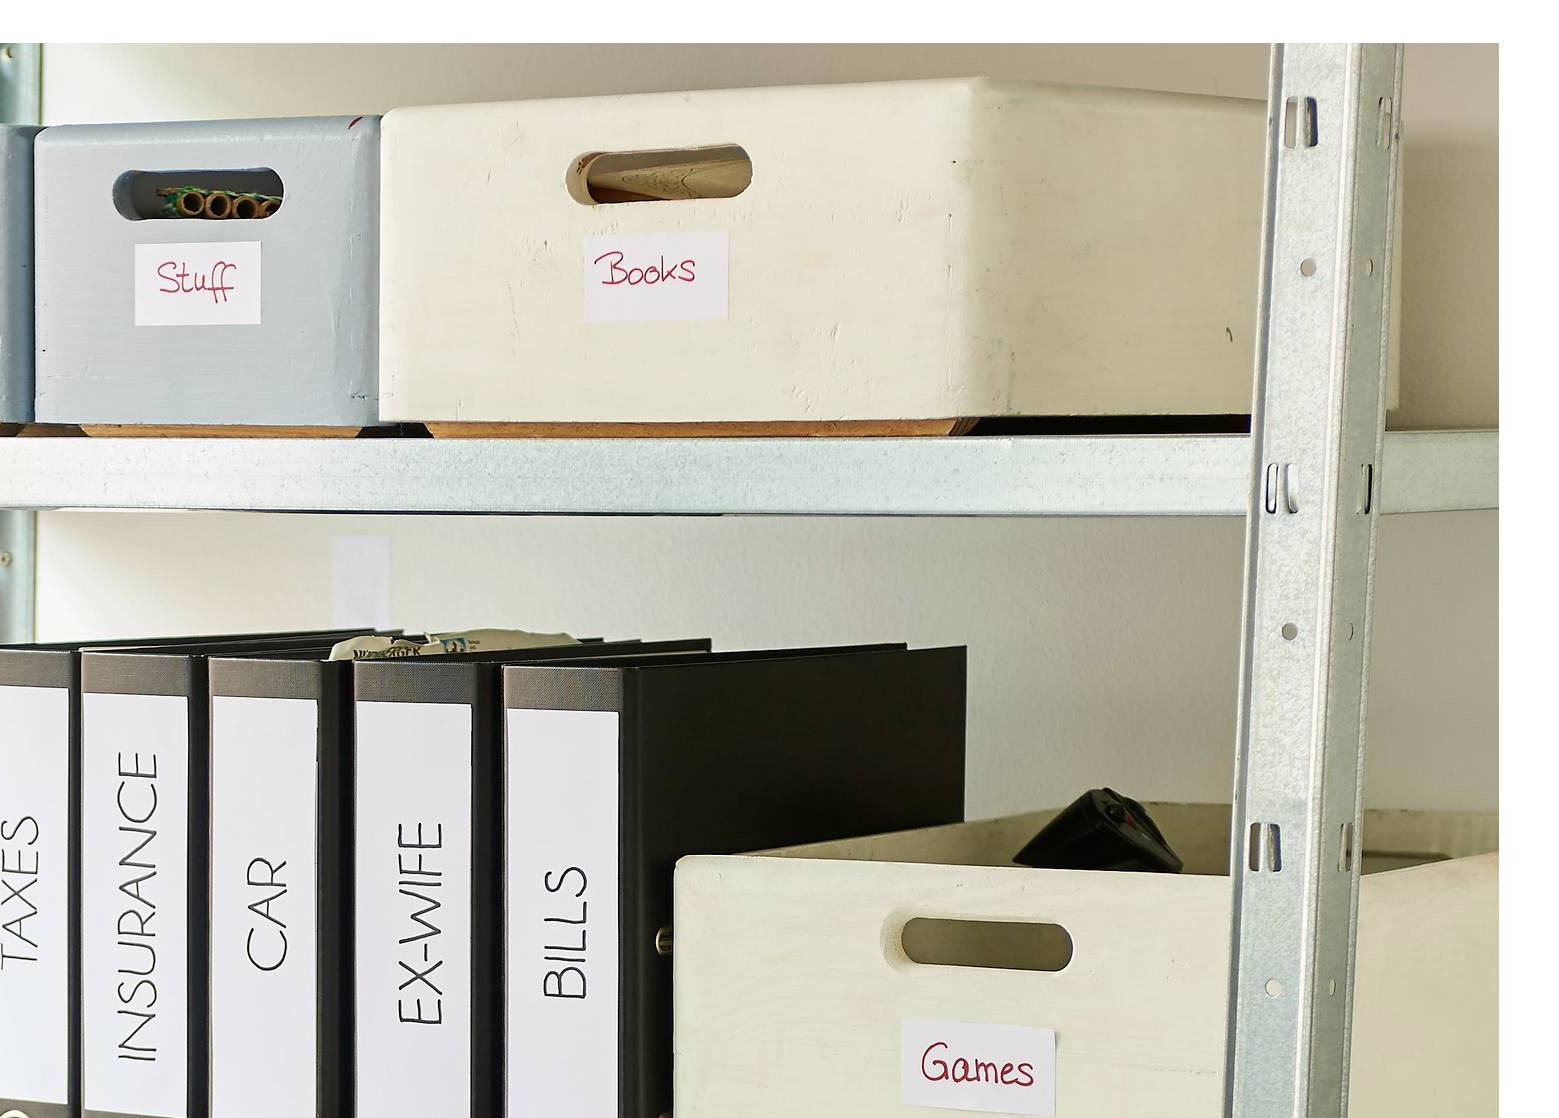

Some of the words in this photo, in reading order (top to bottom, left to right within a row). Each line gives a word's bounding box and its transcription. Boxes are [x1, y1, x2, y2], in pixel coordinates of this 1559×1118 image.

[157, 260, 237, 304] Stuff
[593, 250, 696, 286] Books
[0, 814, 39, 971] TAXES
[117, 751, 157, 1062] INSURANCE
[246, 856, 288, 973] CAR
[397, 821, 442, 1025] EX-WIFE
[543, 865, 588, 1000] BILLS
[921, 1041, 1035, 1087] Games
